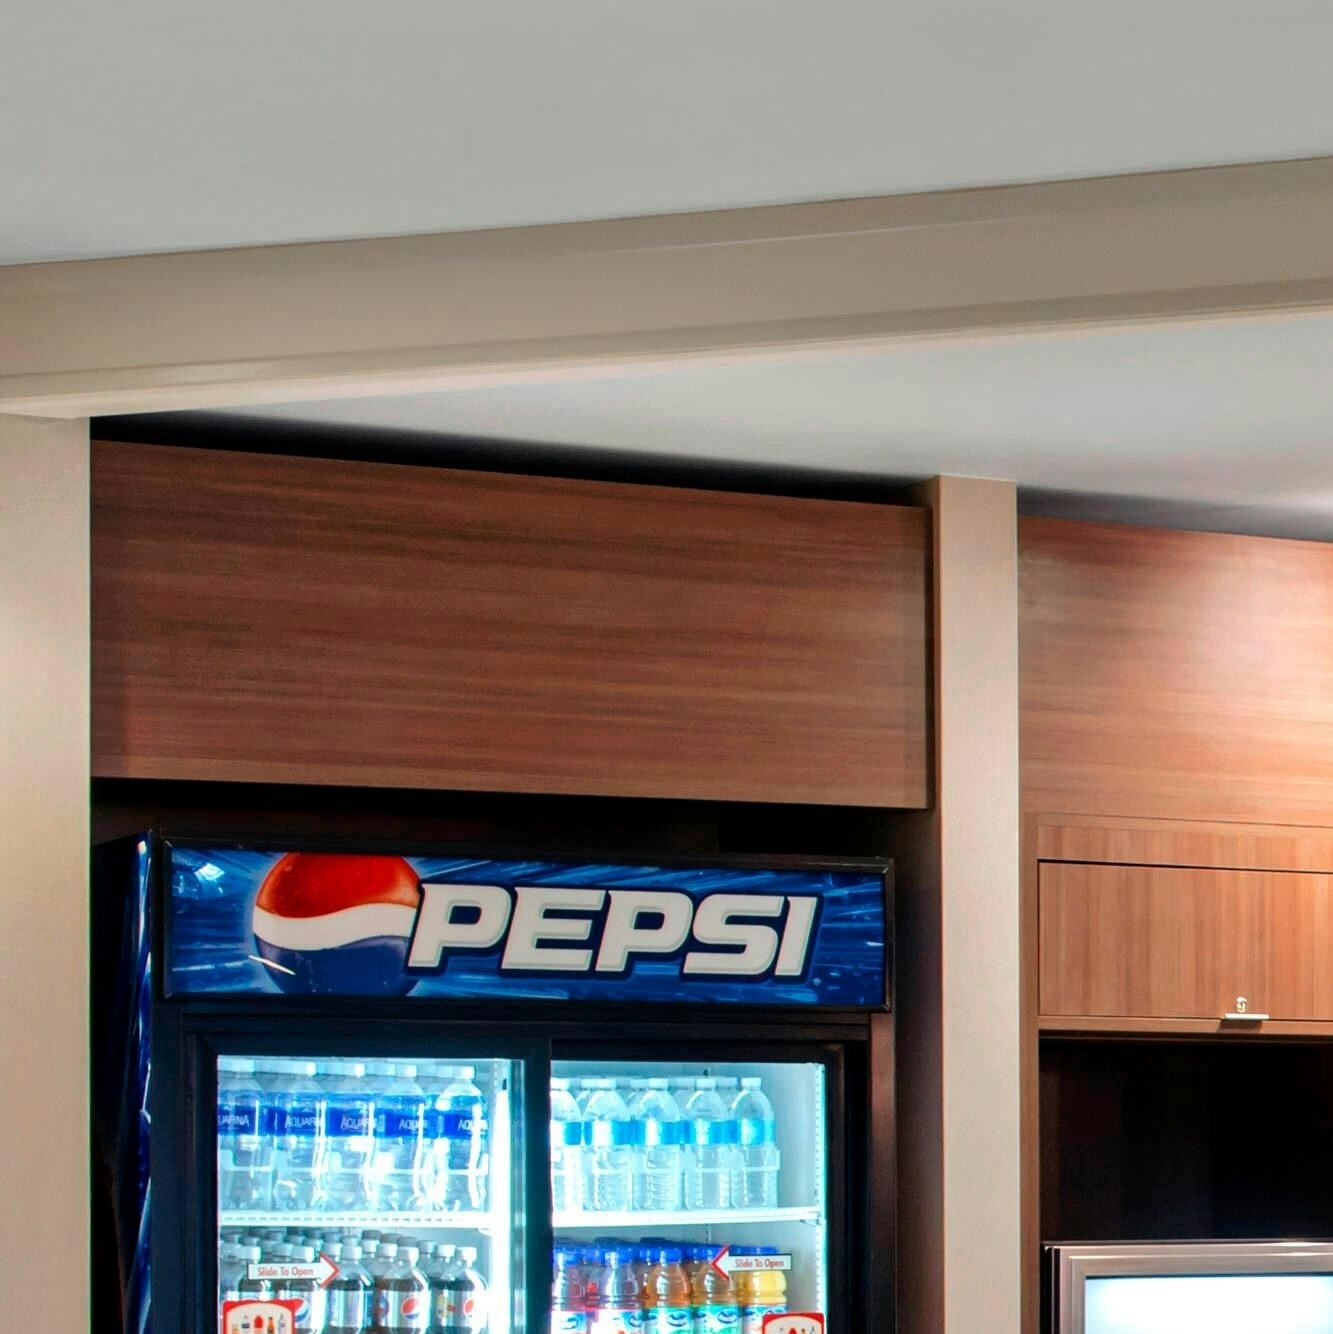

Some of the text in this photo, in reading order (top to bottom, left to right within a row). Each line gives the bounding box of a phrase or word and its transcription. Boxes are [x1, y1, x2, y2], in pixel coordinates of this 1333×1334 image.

[408, 883, 818, 977] PEPSI
[755, 1258, 763, 1268] To
[764, 1258, 785, 1270] Open
[257, 1266, 314, 1278] Slide To Open
